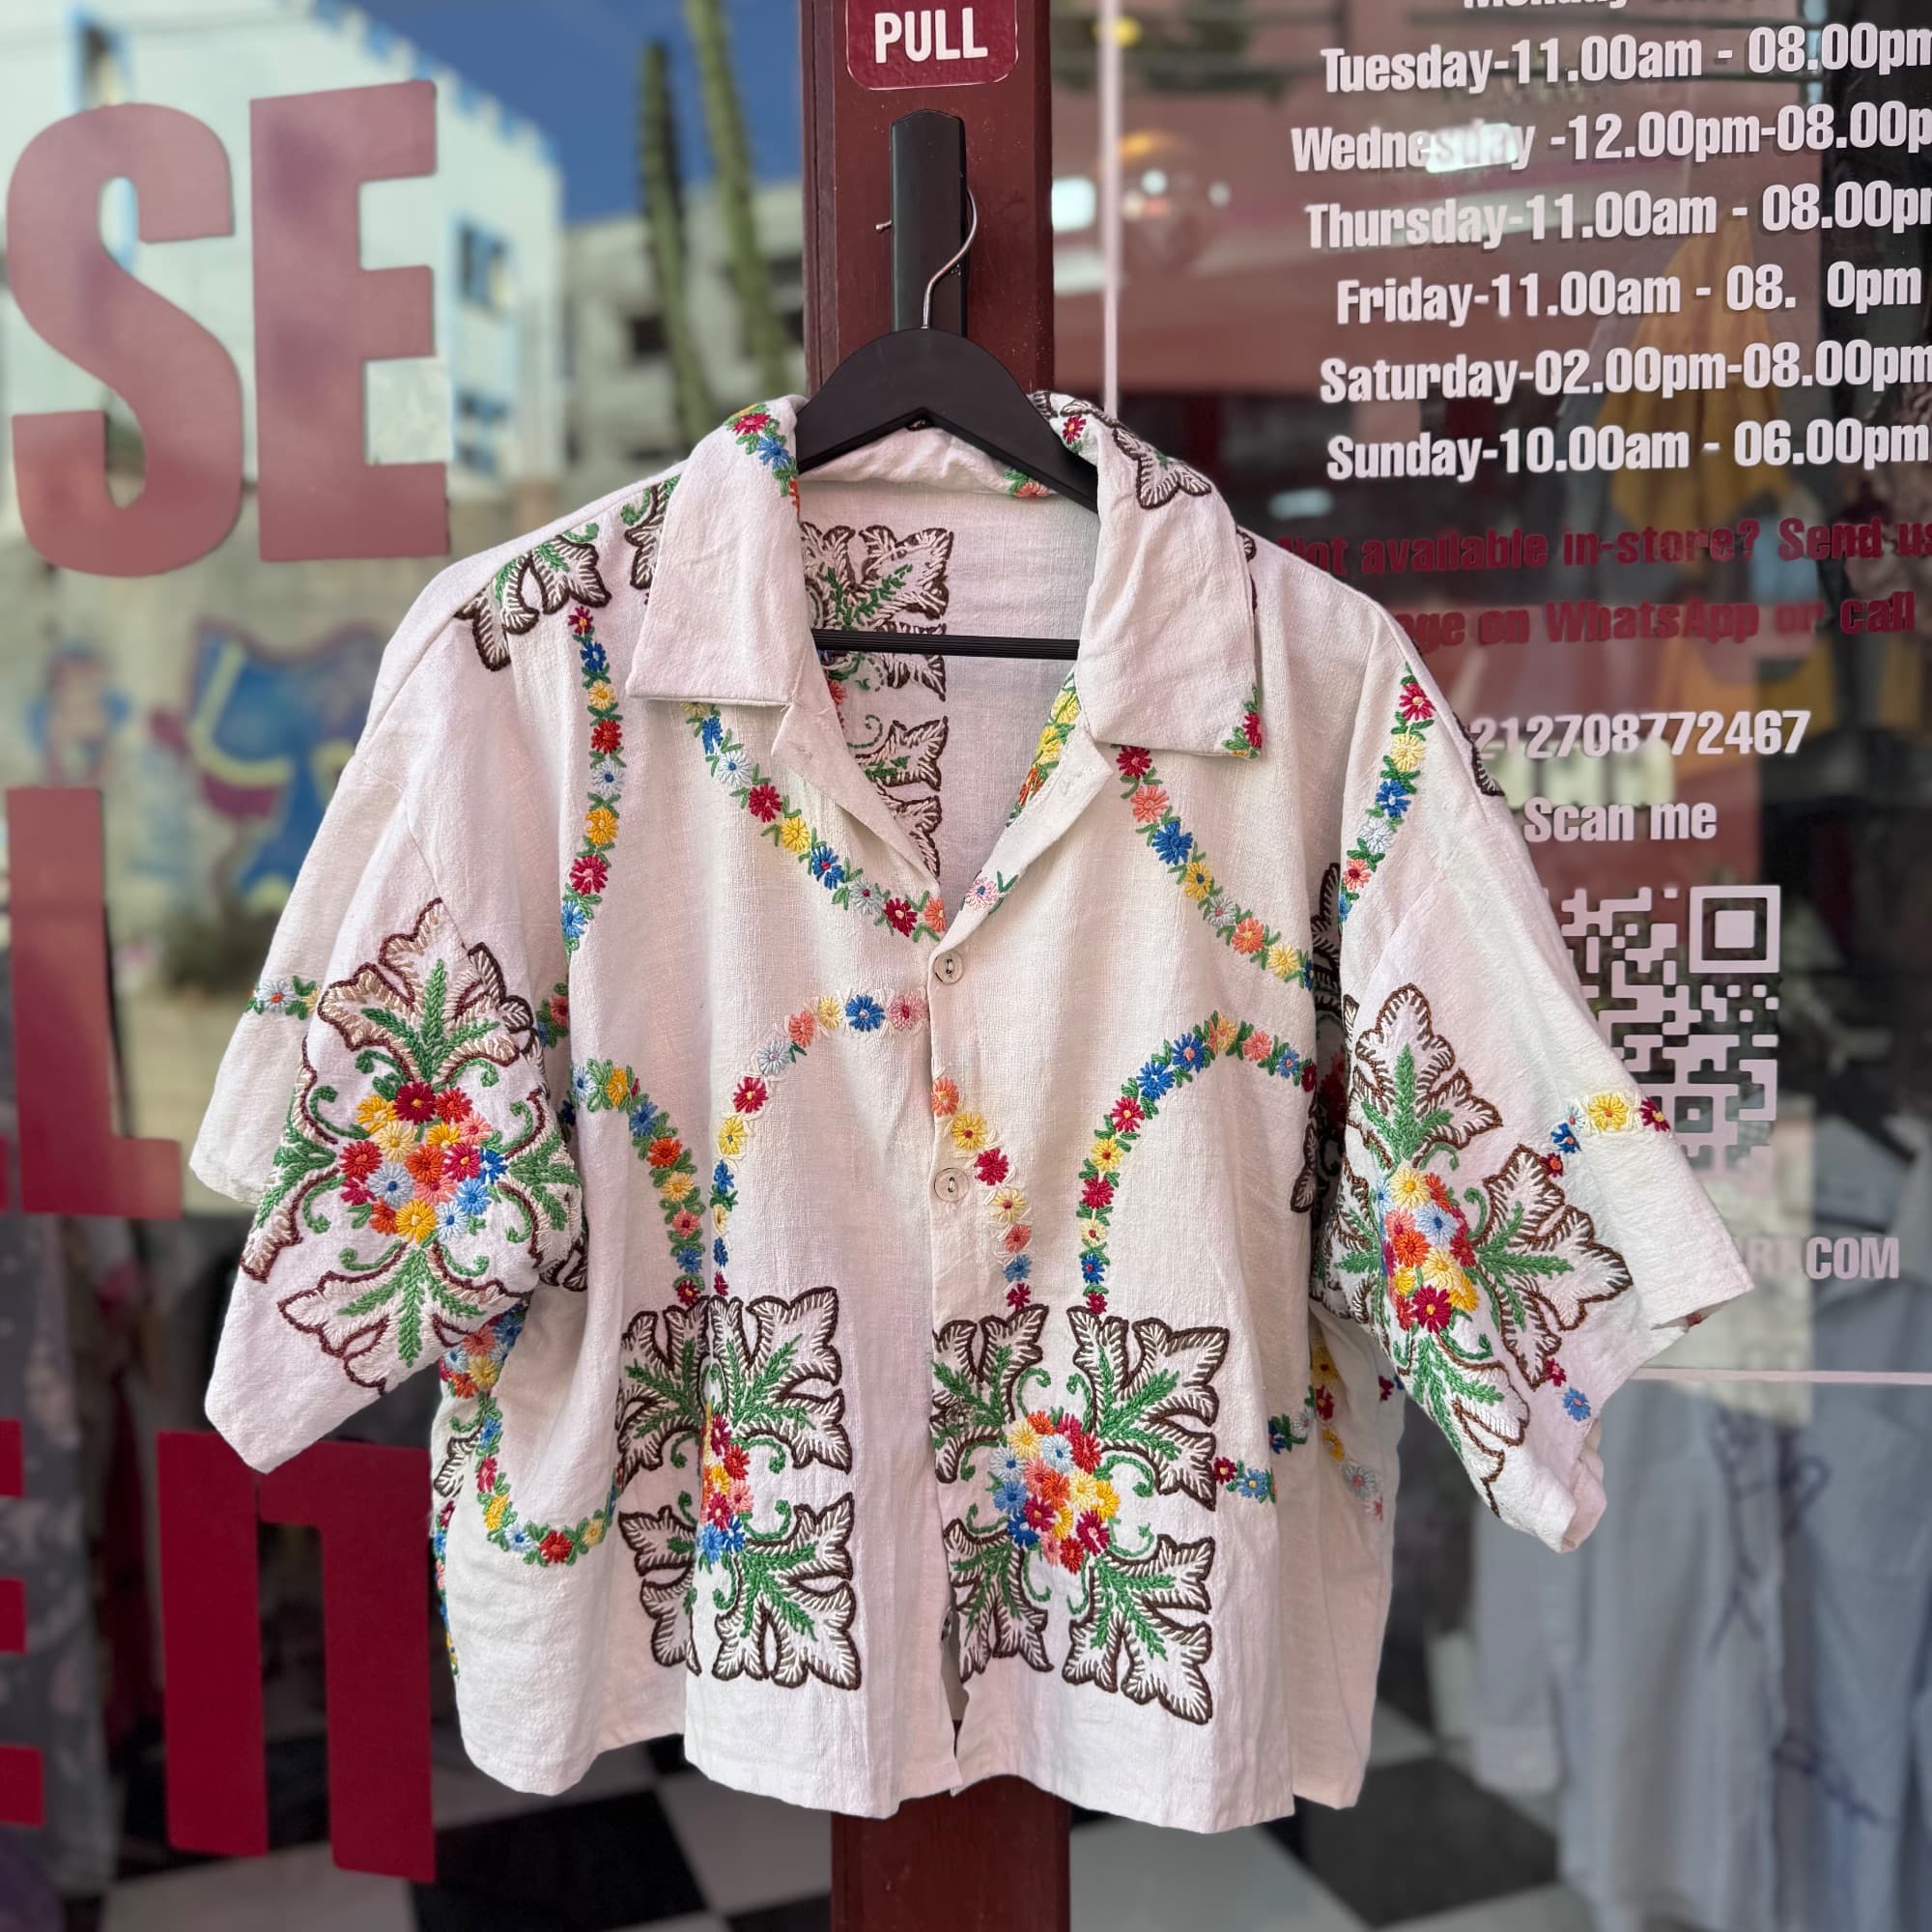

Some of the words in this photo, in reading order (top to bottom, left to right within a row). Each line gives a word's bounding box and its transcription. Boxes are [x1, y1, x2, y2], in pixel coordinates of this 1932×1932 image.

[873, 8, 989, 64] PULL
[1320, 34, 1702, 94] Tuesday-11.00am
[1747, 22, 1932, 75] 08.00pm
[1304, 190, 1717, 250] Thursday-11.00am
[1337, 270, 1681, 327] Friday-11.00am
[6, 79, 450, 578] SE
[1326, 424, 1690, 483] Sunday-10.00am
[1734, 417, 1930, 470] 06.00pm
[1360, 528, 1548, 573] available
[1562, 519, 1760, 566] in-store?
[1777, 517, 1882, 561] Send
[1478, 609, 1531, 645] on
[1546, 599, 1760, 644] WhatsApp
[1775, 601, 1826, 635] or
[1840, 590, 1916, 635] call
[1469, 710, 1811, 760] 212708772467
[1523, 796, 1634, 843] Scan
[1650, 801, 1718, 839] me
[0, 787, 182, 1220] L
